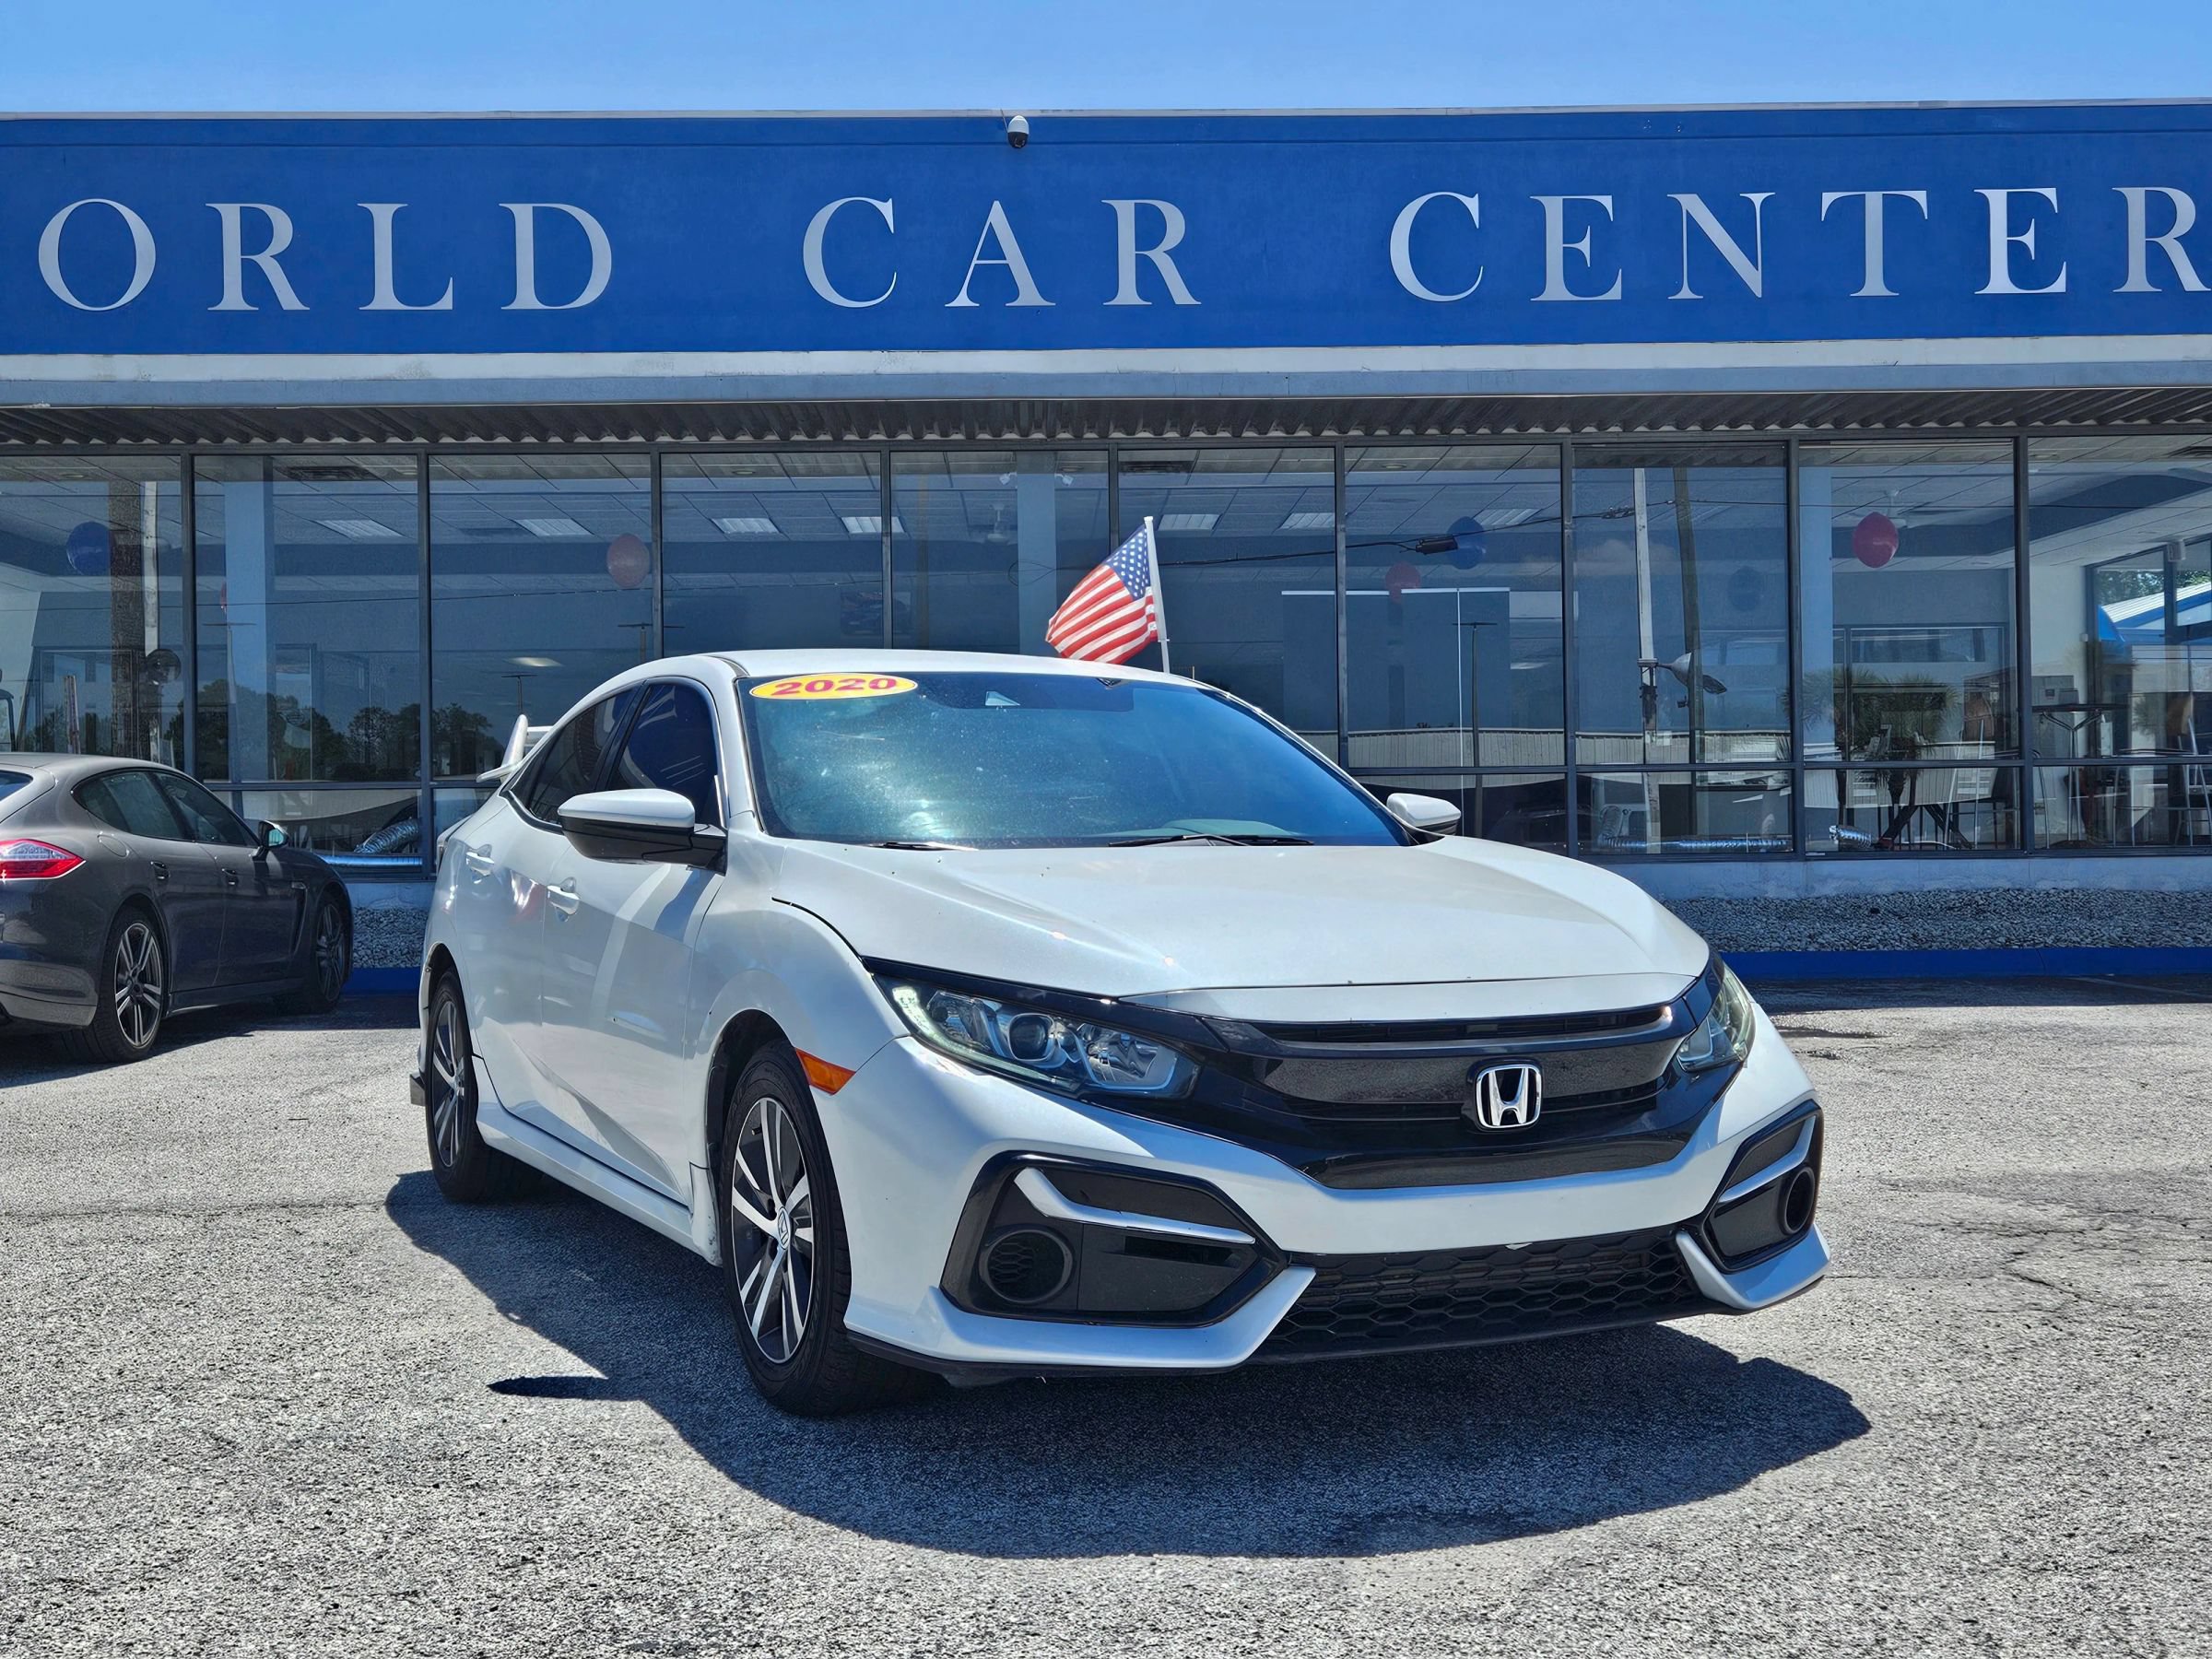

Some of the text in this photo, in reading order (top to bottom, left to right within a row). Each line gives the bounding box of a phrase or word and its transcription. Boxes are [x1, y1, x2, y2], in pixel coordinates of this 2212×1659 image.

[38, 187, 2211, 311] ORLD CAR CENTER
[771, 677, 898, 696] 2020
